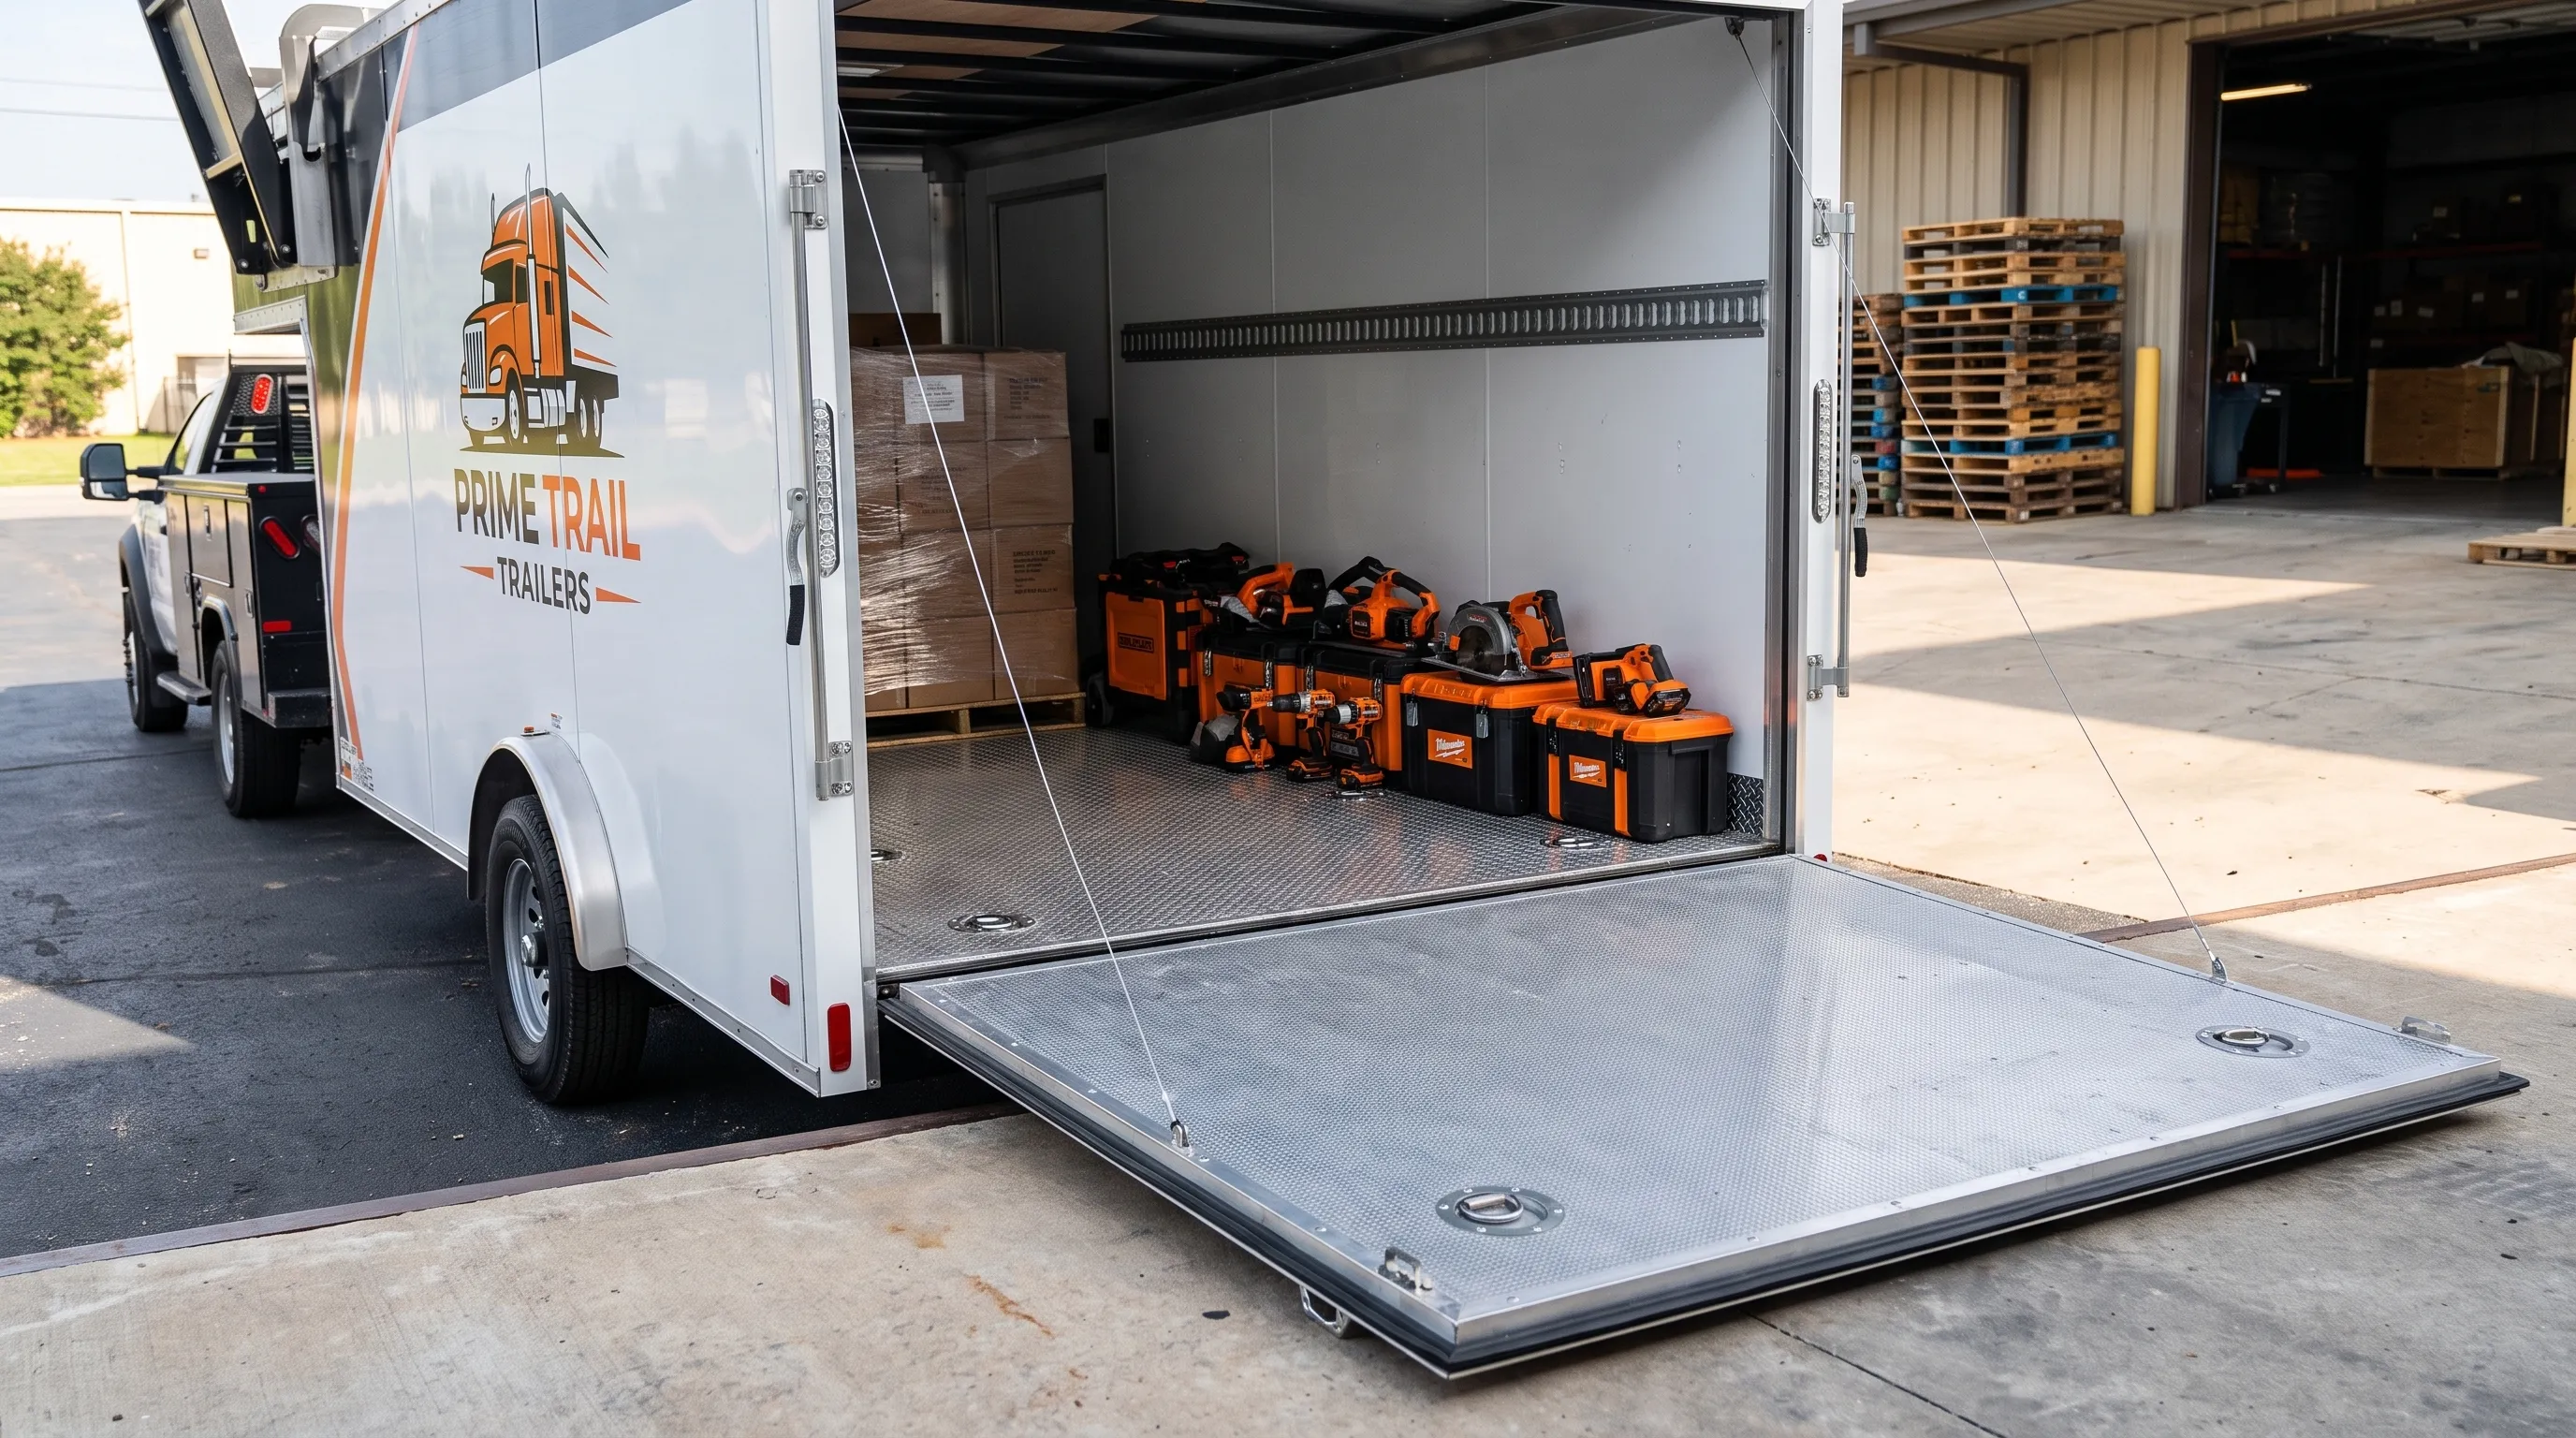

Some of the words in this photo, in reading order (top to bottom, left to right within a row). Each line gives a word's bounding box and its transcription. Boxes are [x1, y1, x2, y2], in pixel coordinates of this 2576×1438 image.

[454, 468, 540, 545] PRIME
[542, 475, 641, 562] TRAIL
[497, 556, 592, 615] TRAILERS
